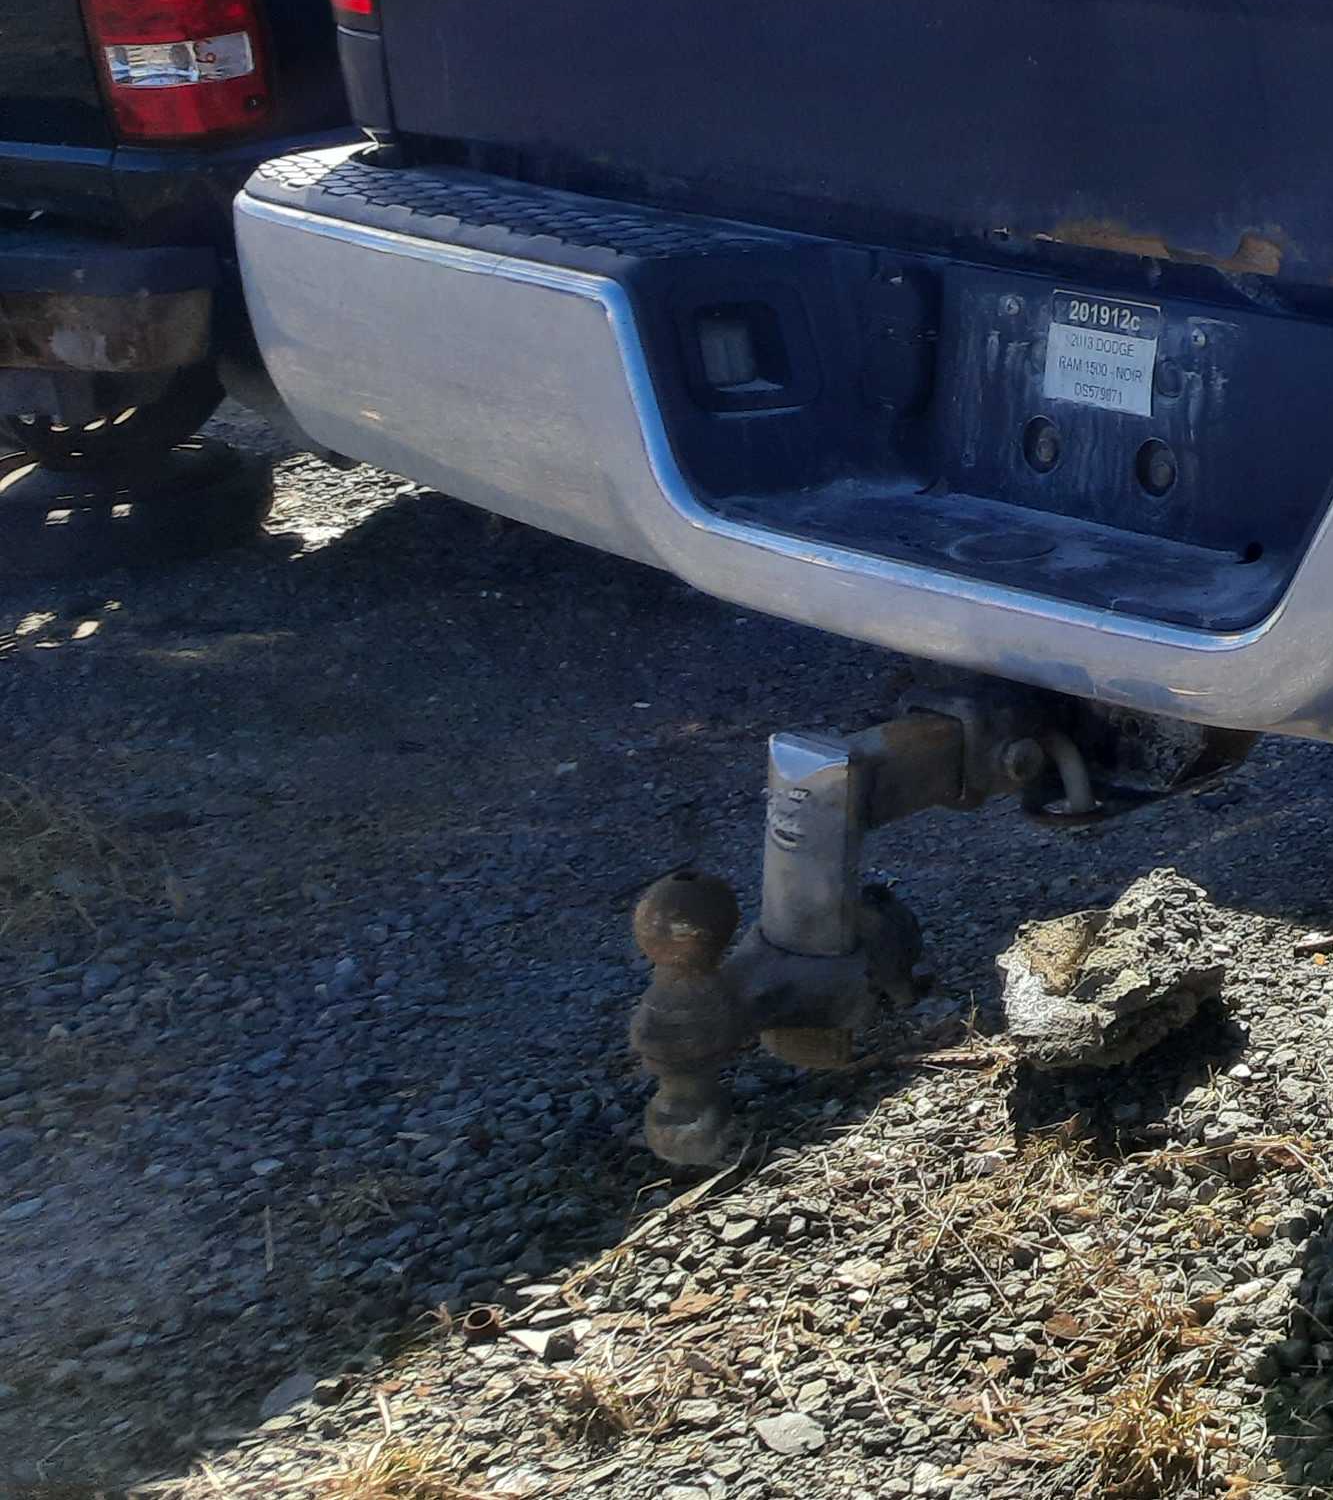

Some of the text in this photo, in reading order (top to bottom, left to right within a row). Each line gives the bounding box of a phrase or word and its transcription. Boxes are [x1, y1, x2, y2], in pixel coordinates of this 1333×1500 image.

[1069, 300, 1141, 332] 201912c
[1096, 338, 1135, 358] DODGE
[1058, 356, 1082, 372] RAM
[1085, 360, 1108, 377] 1500
[1115, 365, 1143, 383] NOIR
